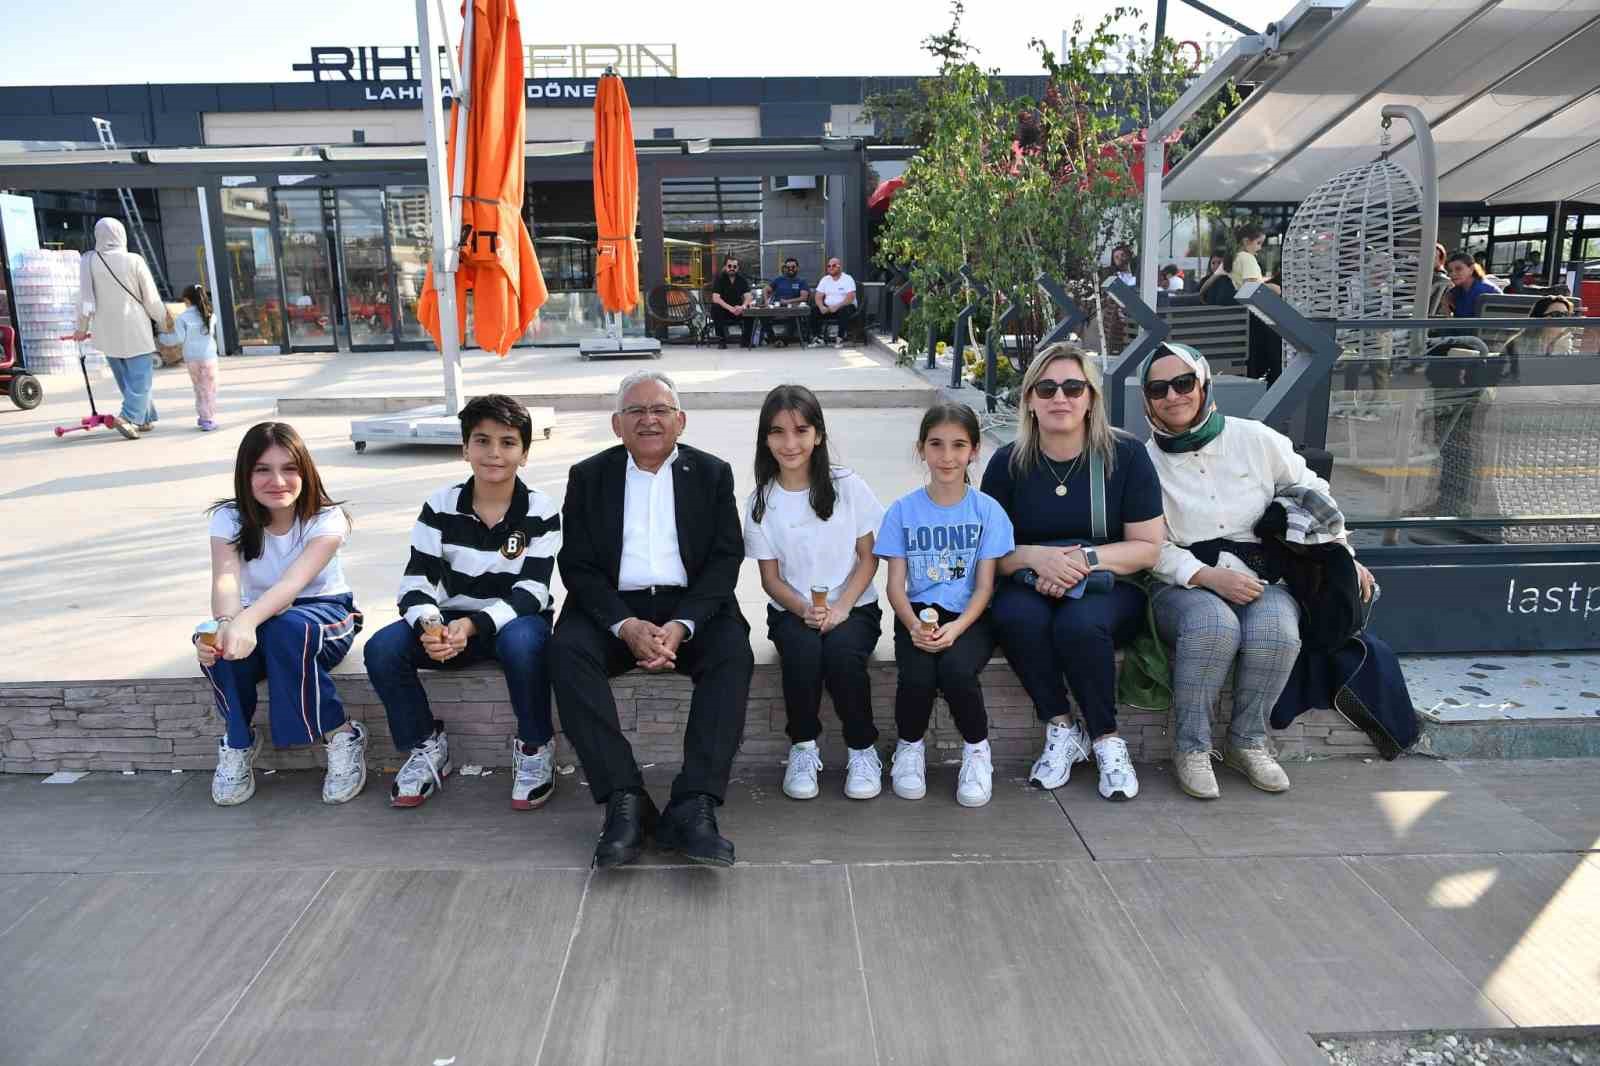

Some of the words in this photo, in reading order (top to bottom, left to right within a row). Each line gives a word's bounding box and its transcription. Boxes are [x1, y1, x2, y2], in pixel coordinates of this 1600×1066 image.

[529, 43, 677, 78] FIRIN
[527, 82, 597, 99] DÖNE
[903, 524, 983, 551] LOONE
